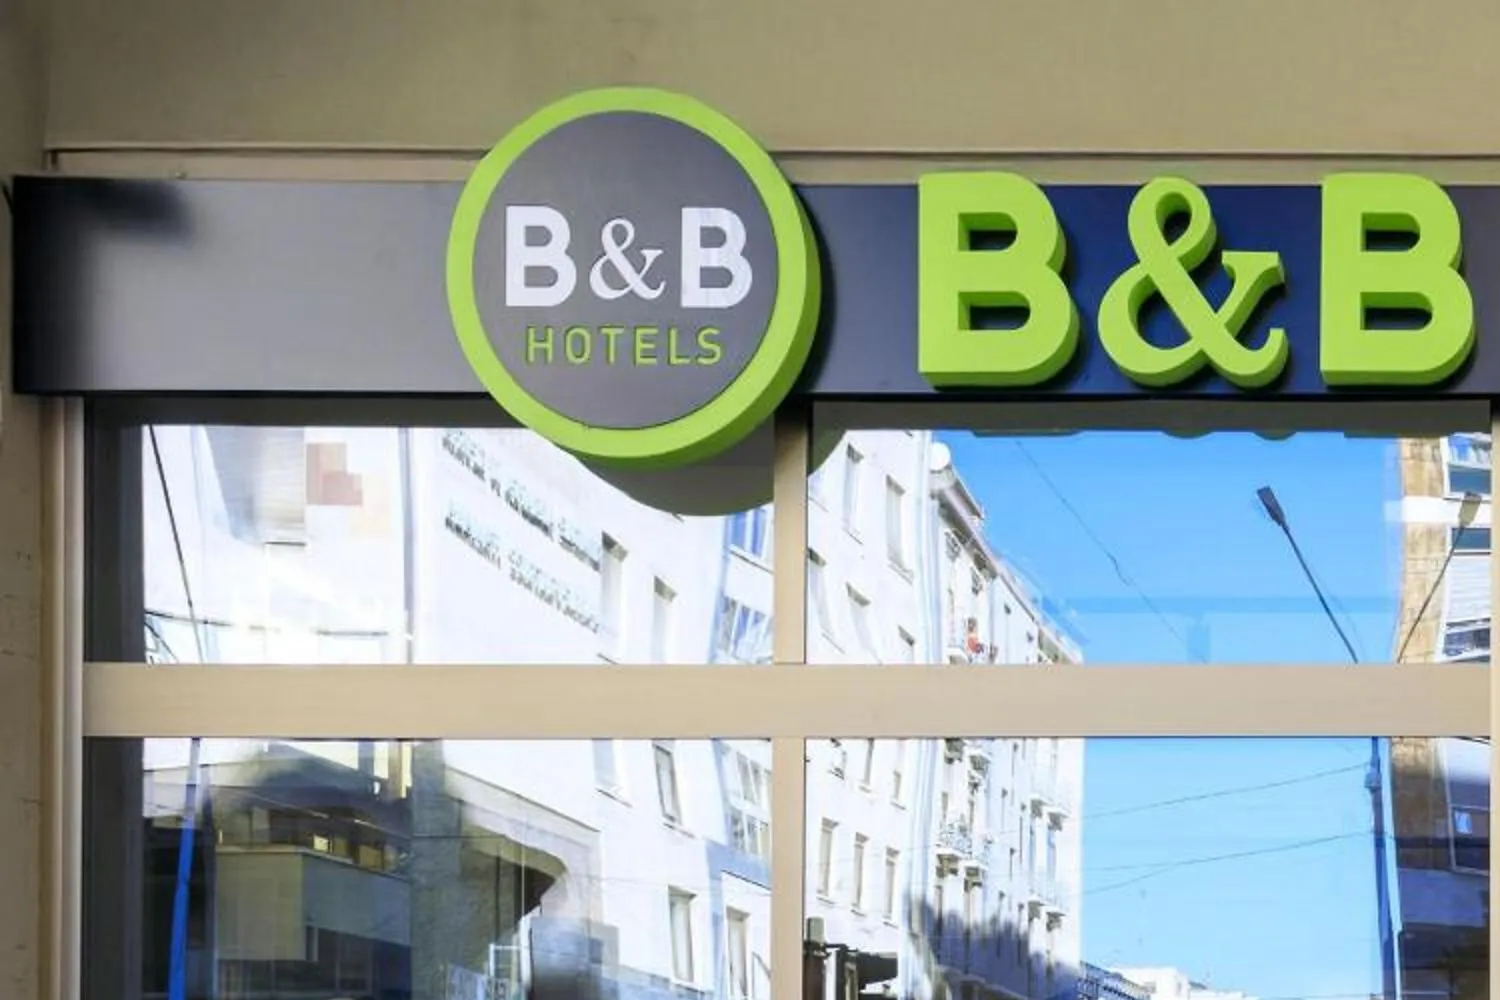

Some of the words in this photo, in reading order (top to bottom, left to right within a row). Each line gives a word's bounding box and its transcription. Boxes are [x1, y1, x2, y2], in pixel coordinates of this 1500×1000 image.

[505, 205, 753, 308] B&B
[918, 172, 1476, 388] B&B
[525, 325, 724, 365] HOTELS
